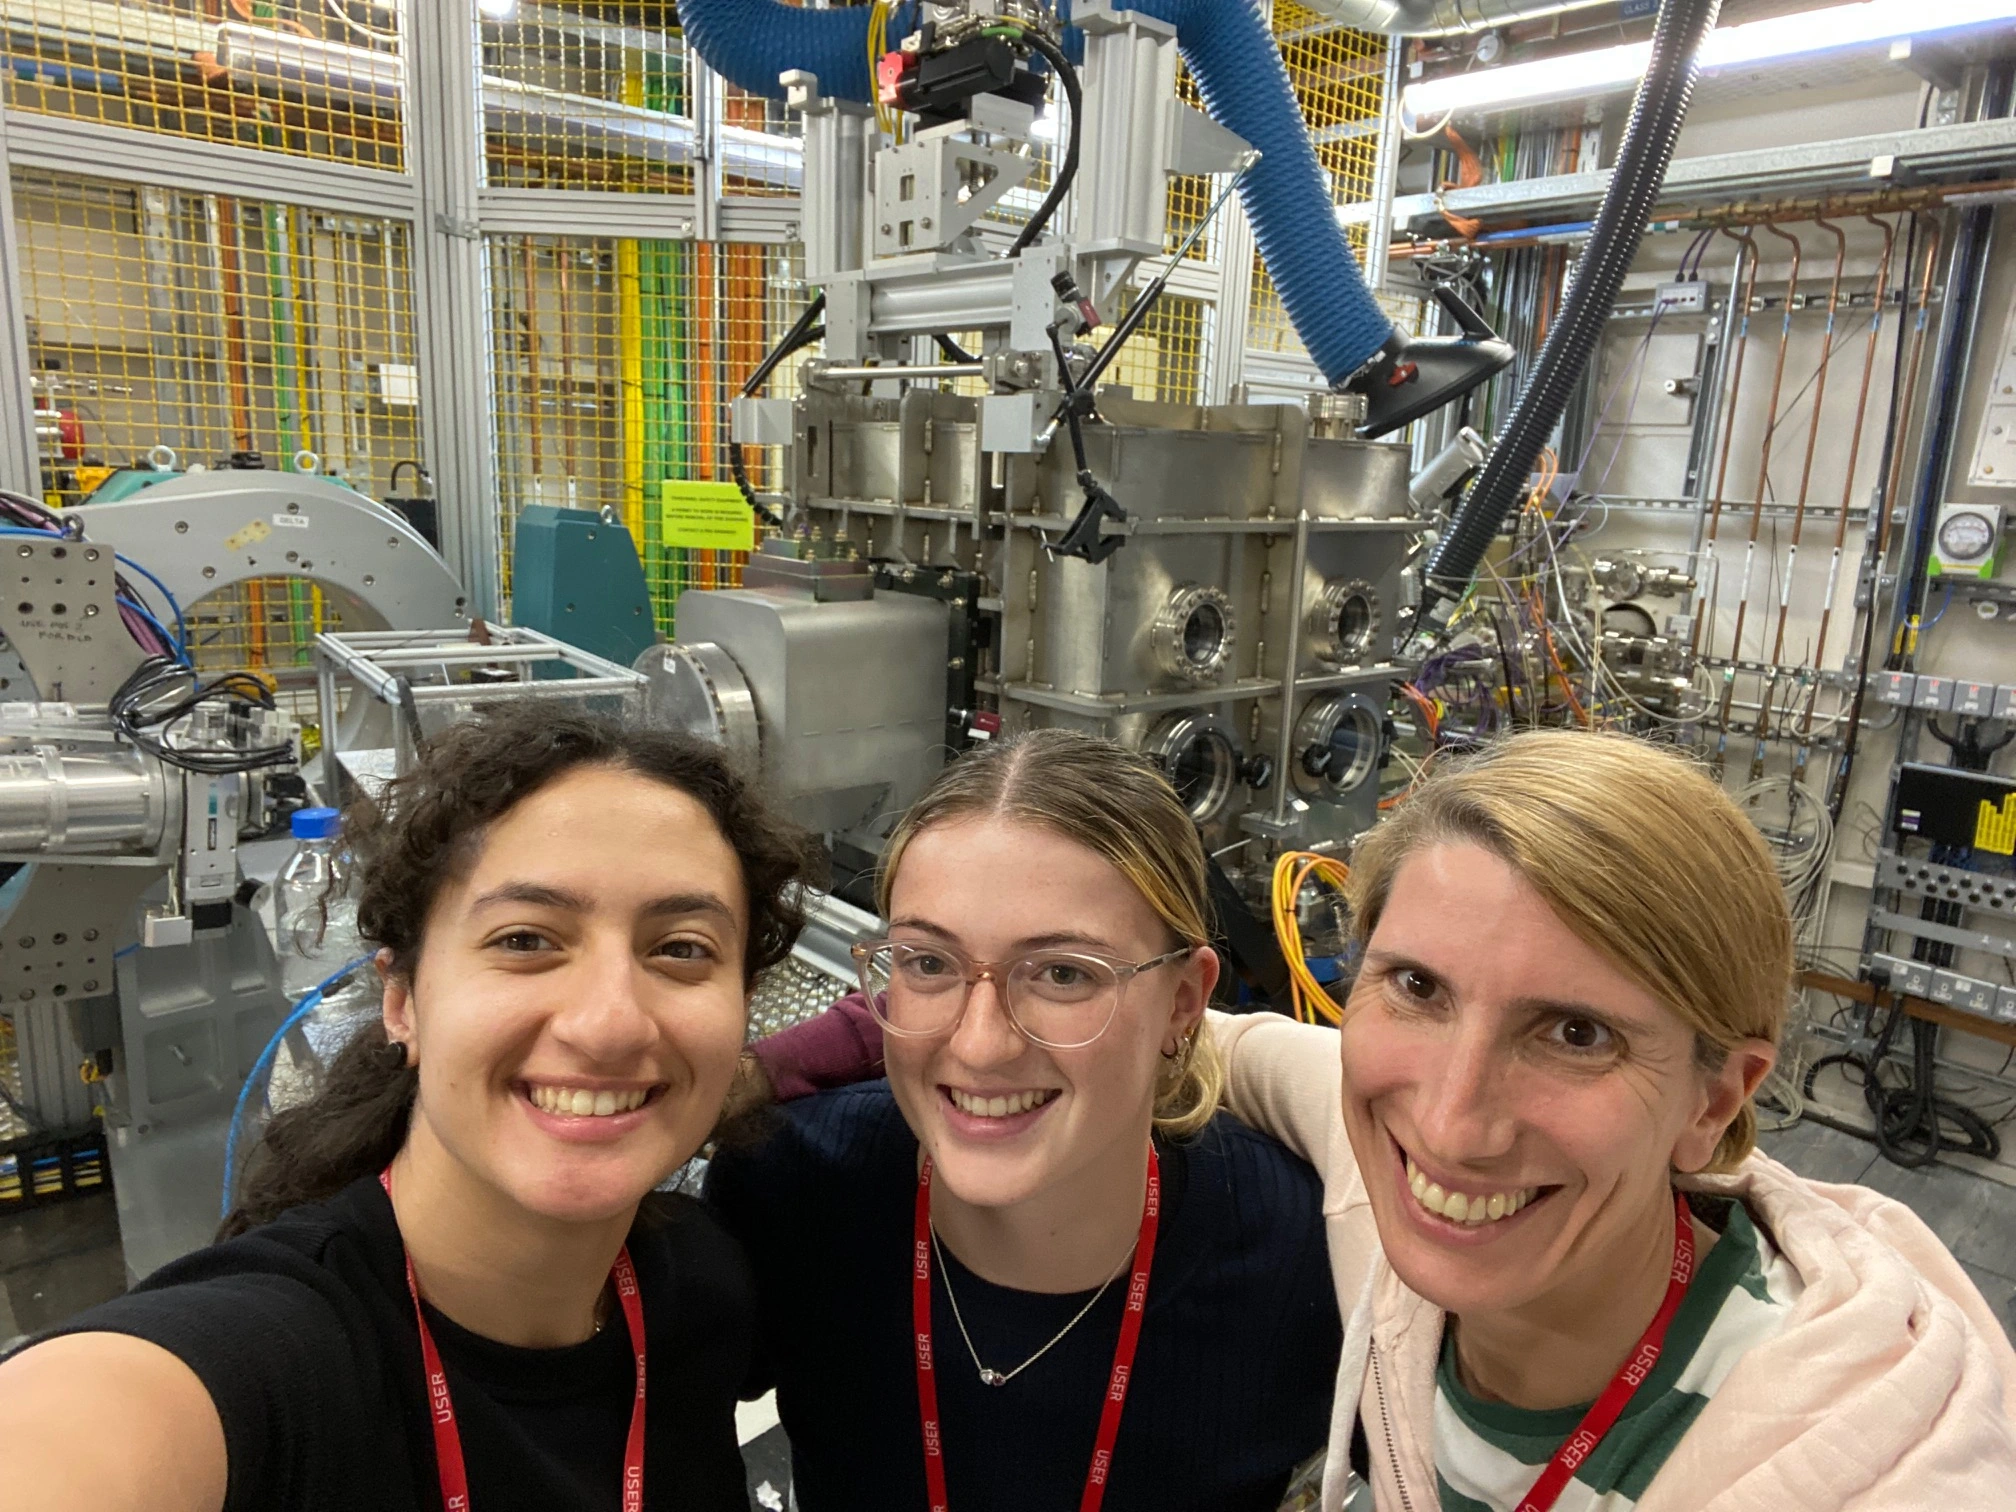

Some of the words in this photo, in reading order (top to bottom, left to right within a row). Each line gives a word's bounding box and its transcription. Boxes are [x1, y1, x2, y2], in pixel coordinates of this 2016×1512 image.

[1146, 1177, 1159, 1217] USER
[613, 1257, 635, 1297] USER
[917, 1240, 928, 1280] USER
[1671, 1239, 1693, 1284] USER
[1128, 1272, 1147, 1312] USER
[918, 1333, 931, 1370] USER
[1621, 1343, 1659, 1387] USER
[431, 1372, 452, 1424] USER
[1109, 1365, 1129, 1402] USER
[925, 1420, 940, 1456] USER
[1560, 1430, 1597, 1469] USER
[1091, 1449, 1110, 1485] USER
[627, 1466, 640, 1512] USER
